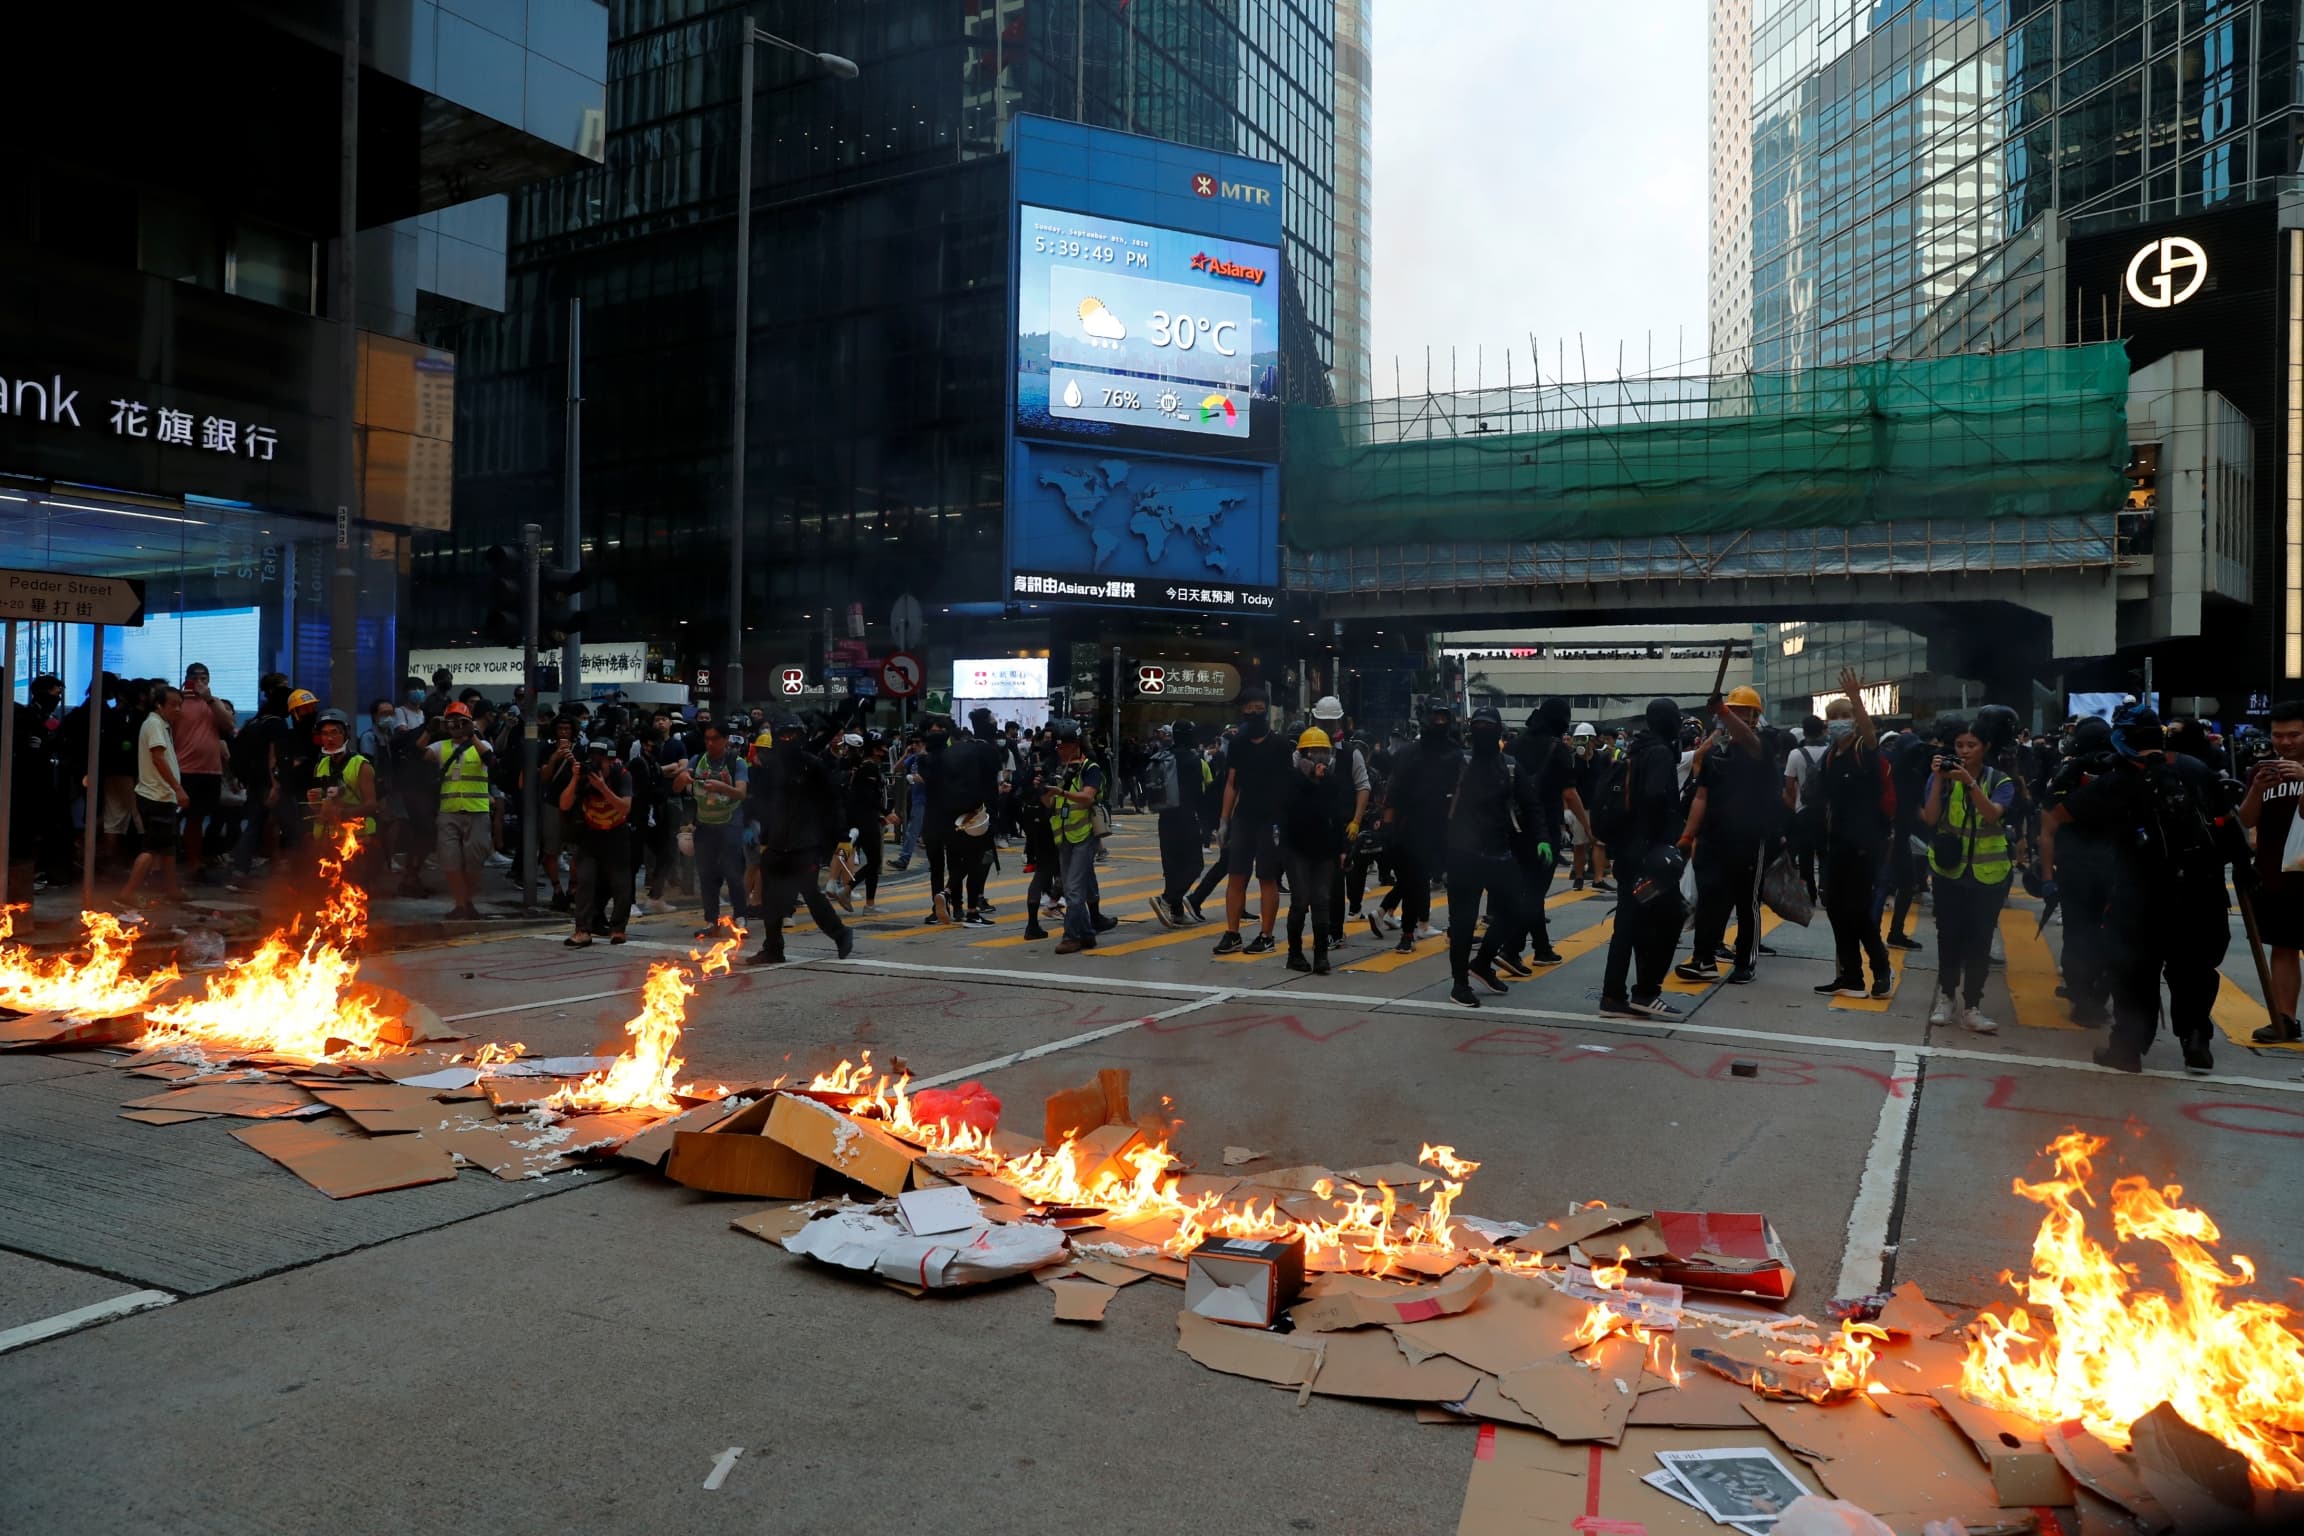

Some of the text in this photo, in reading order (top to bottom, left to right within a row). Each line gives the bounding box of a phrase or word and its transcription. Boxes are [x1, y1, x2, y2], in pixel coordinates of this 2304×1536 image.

[1221, 181, 1270, 206] MTR
[1035, 236, 1148, 268] 5:39:49 PM
[1209, 257, 1265, 285] Asiaray
[1151, 310, 1236, 356] 30°C
[1101, 388, 1141, 409] 76%
[109, 398, 278, 461] 花旗銀行
[10, 577, 112, 596] Pedder Street
[1166, 587, 1234, 605] 今日天氣預測
[1241, 592, 1274, 608] Today
[32, 598, 93, 617] 畢打街
[464, 662, 481, 673] FOR
[484, 662, 507, 673] YOUR
